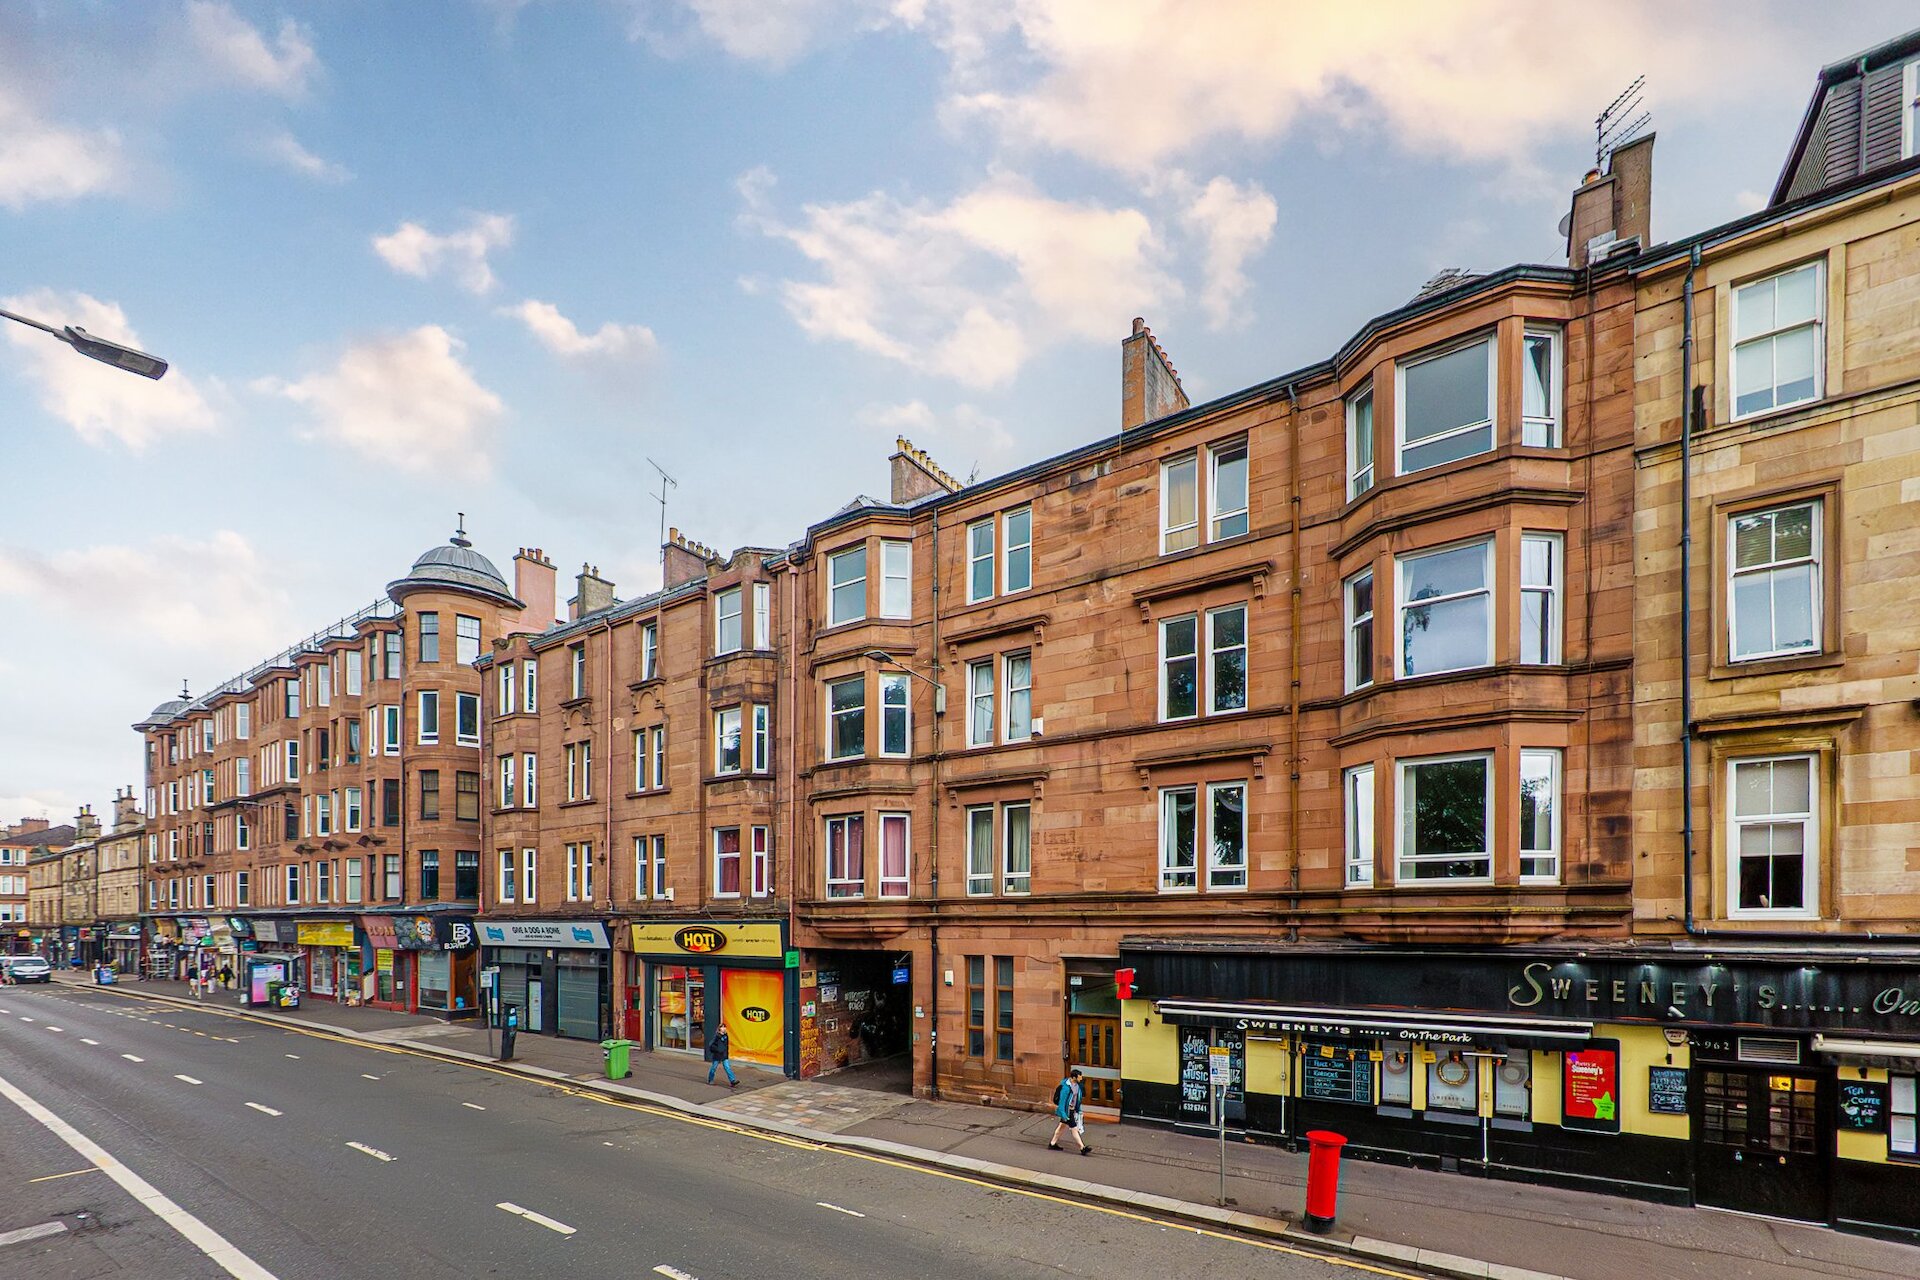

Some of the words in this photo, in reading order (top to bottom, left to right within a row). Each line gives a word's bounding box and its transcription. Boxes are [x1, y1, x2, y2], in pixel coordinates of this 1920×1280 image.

[512, 926, 524, 934] GIVE
[546, 927, 561, 935] BONE
[683, 933, 716, 948] HOT!
[1873, 987, 1920, 1016] On
[746, 1010, 765, 1020] HOT!
[1236, 1018, 1350, 1035] SWEENEY'S
[1400, 1029, 1419, 1040] On
[1419, 1031, 1440, 1042] The
[1441, 1032, 1472, 1043] Park
[1182, 1043, 1209, 1055] SPORT
[1182, 1069, 1209, 1081] MUSIC
[1183, 1088, 1208, 1099] PARTY
[1844, 1086, 1864, 1096] TEA
